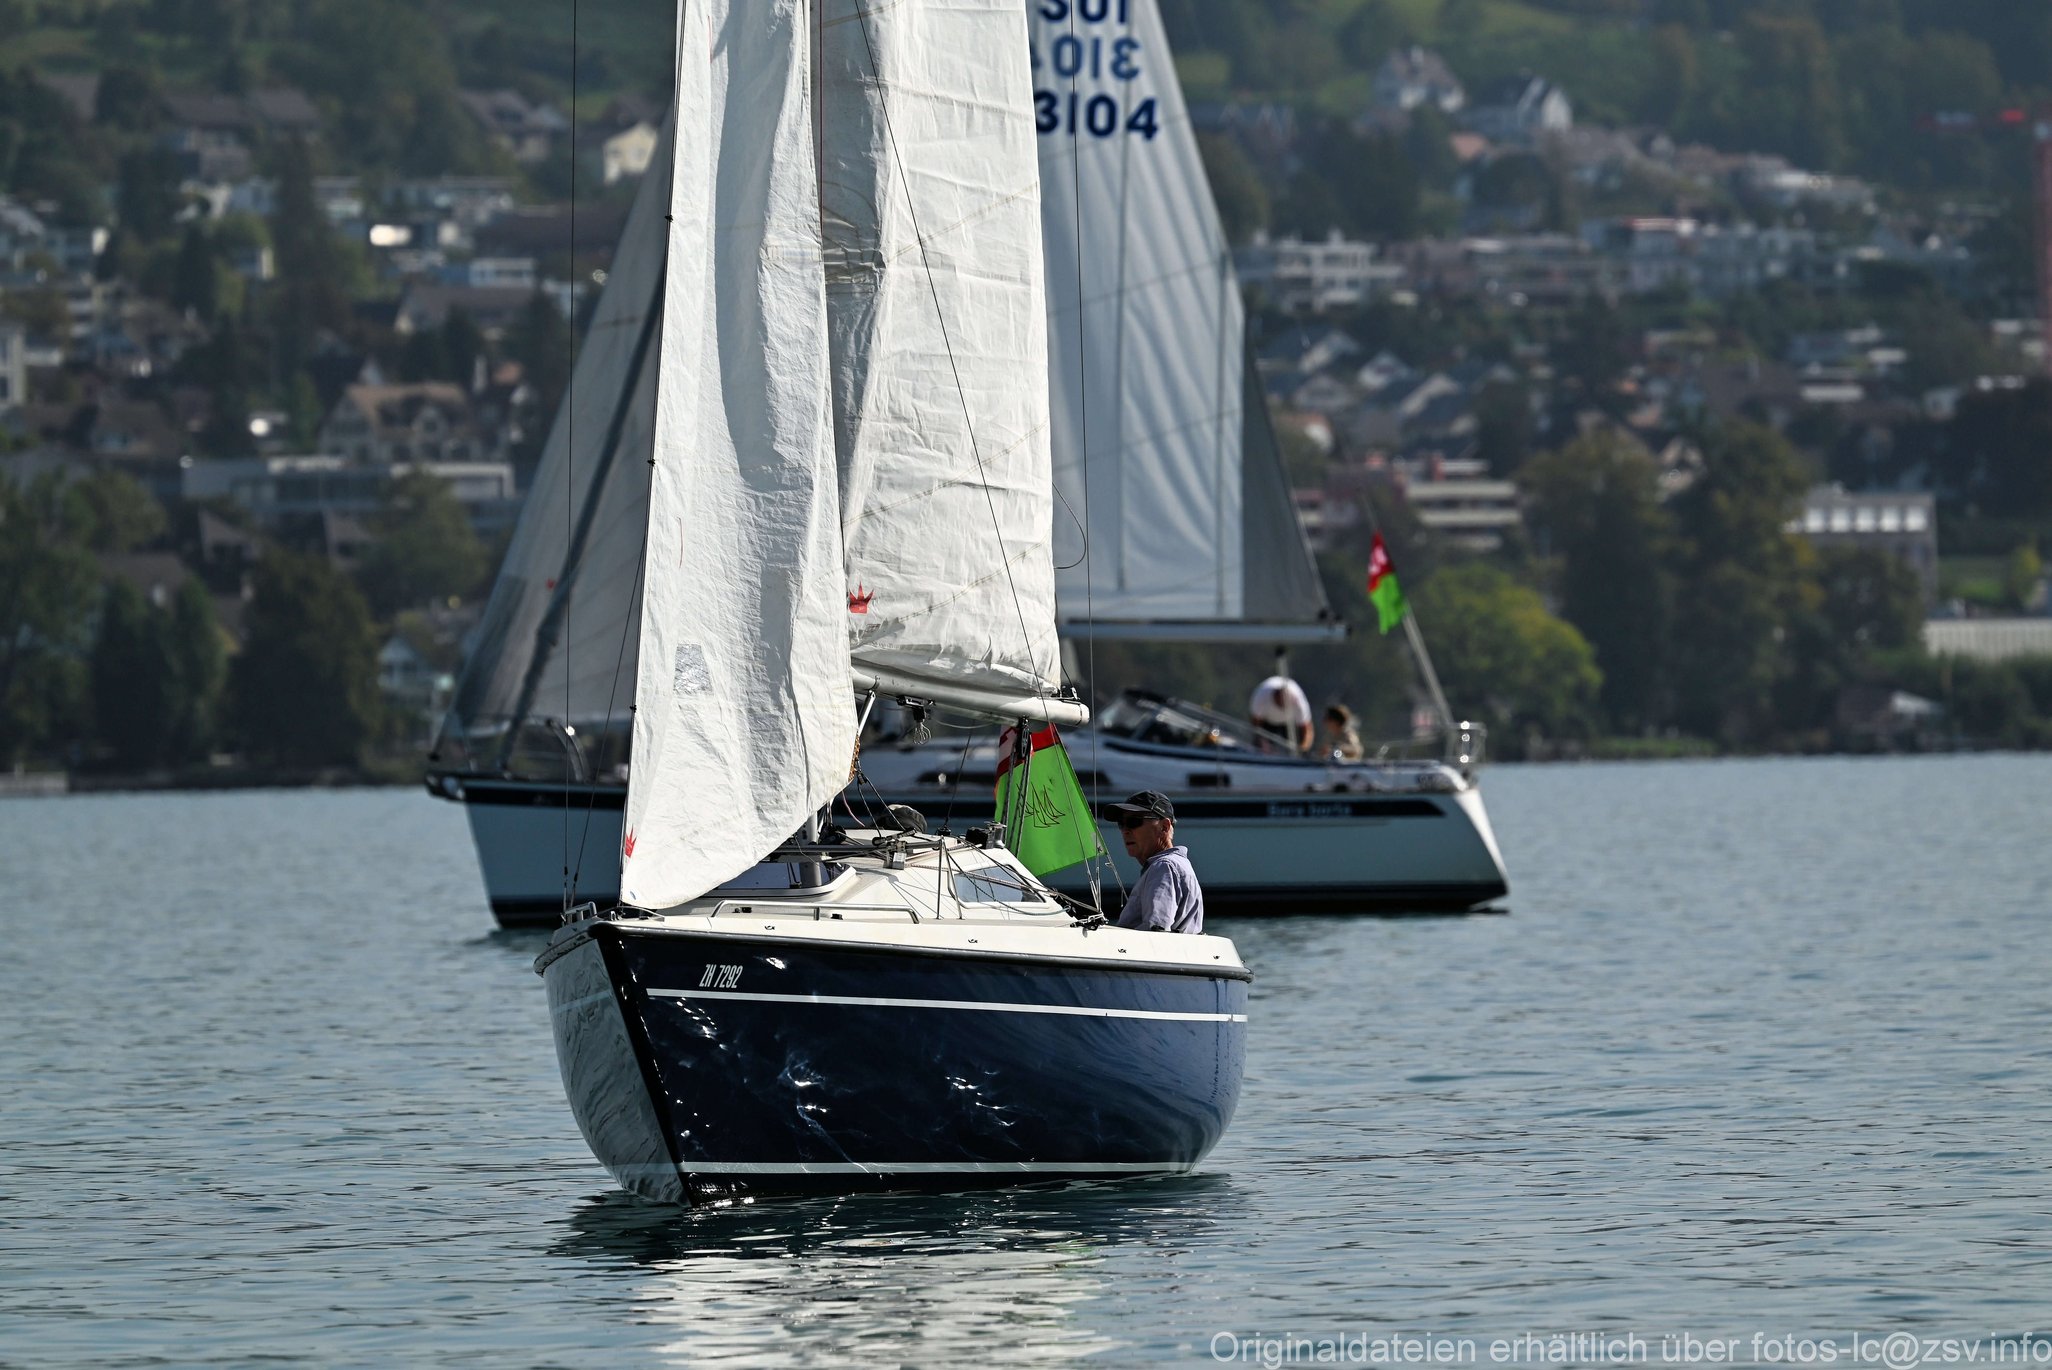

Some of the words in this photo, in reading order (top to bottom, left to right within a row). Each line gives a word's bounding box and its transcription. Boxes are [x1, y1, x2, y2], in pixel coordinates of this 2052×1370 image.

[1033, 90, 1158, 141] 3104
[699, 964, 717, 987] ZH
[713, 964, 743, 988] 7292
